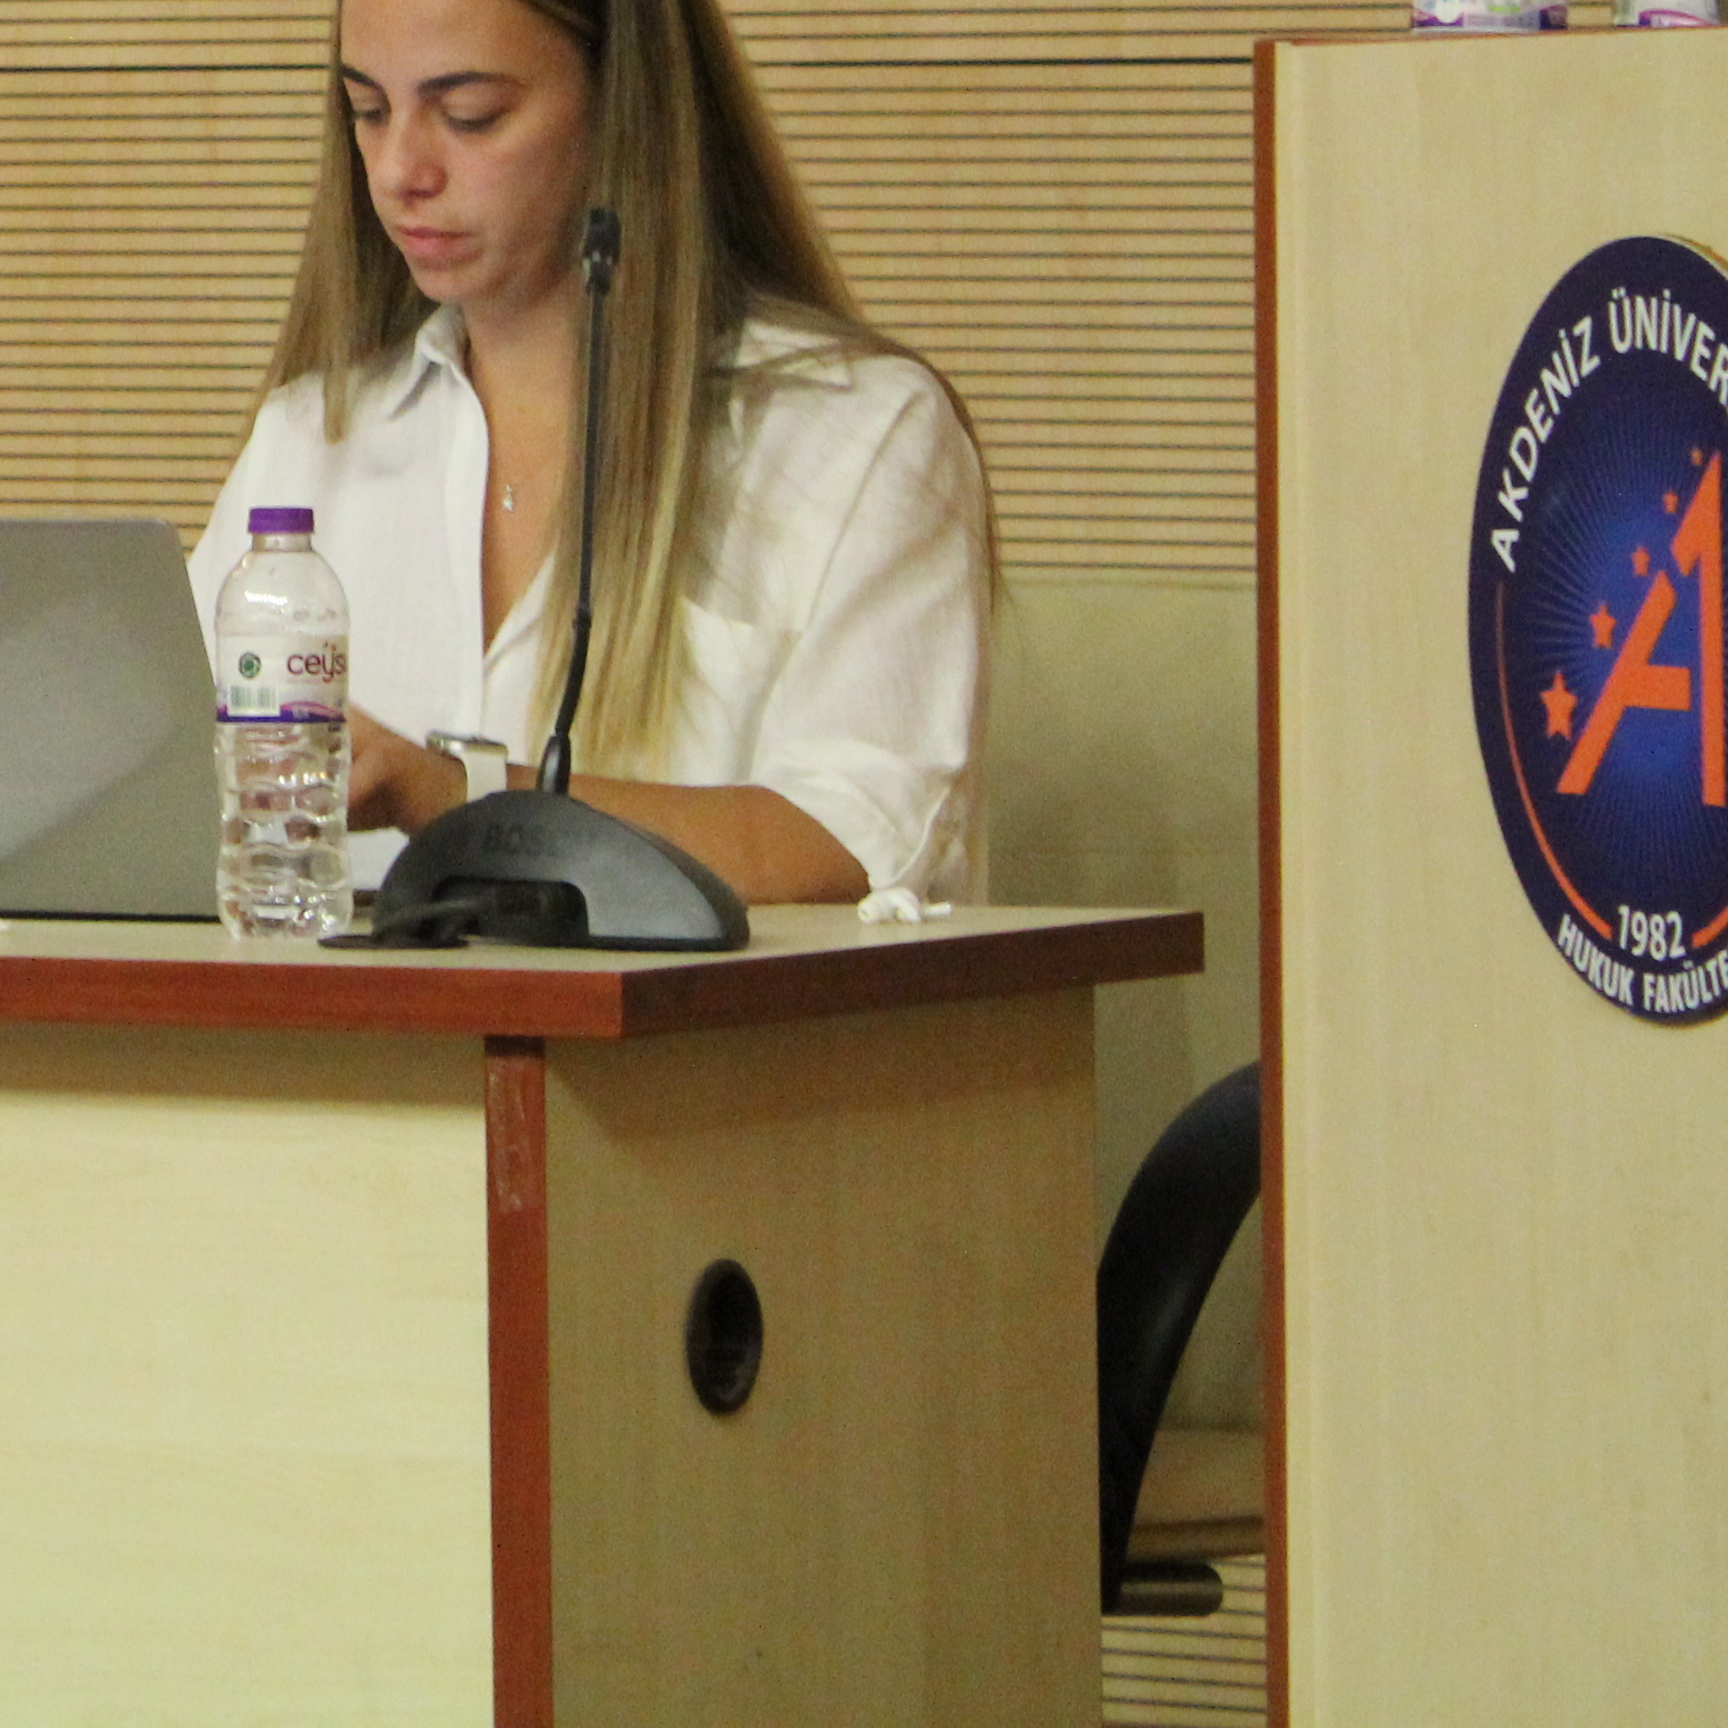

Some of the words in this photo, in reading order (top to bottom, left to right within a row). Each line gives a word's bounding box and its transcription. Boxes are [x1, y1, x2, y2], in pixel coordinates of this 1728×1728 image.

[1491, 315, 1601, 574] AKDENİZ
[1558, 913, 1635, 1006] HUKUK
[1617, 904, 1687, 962] 1982
